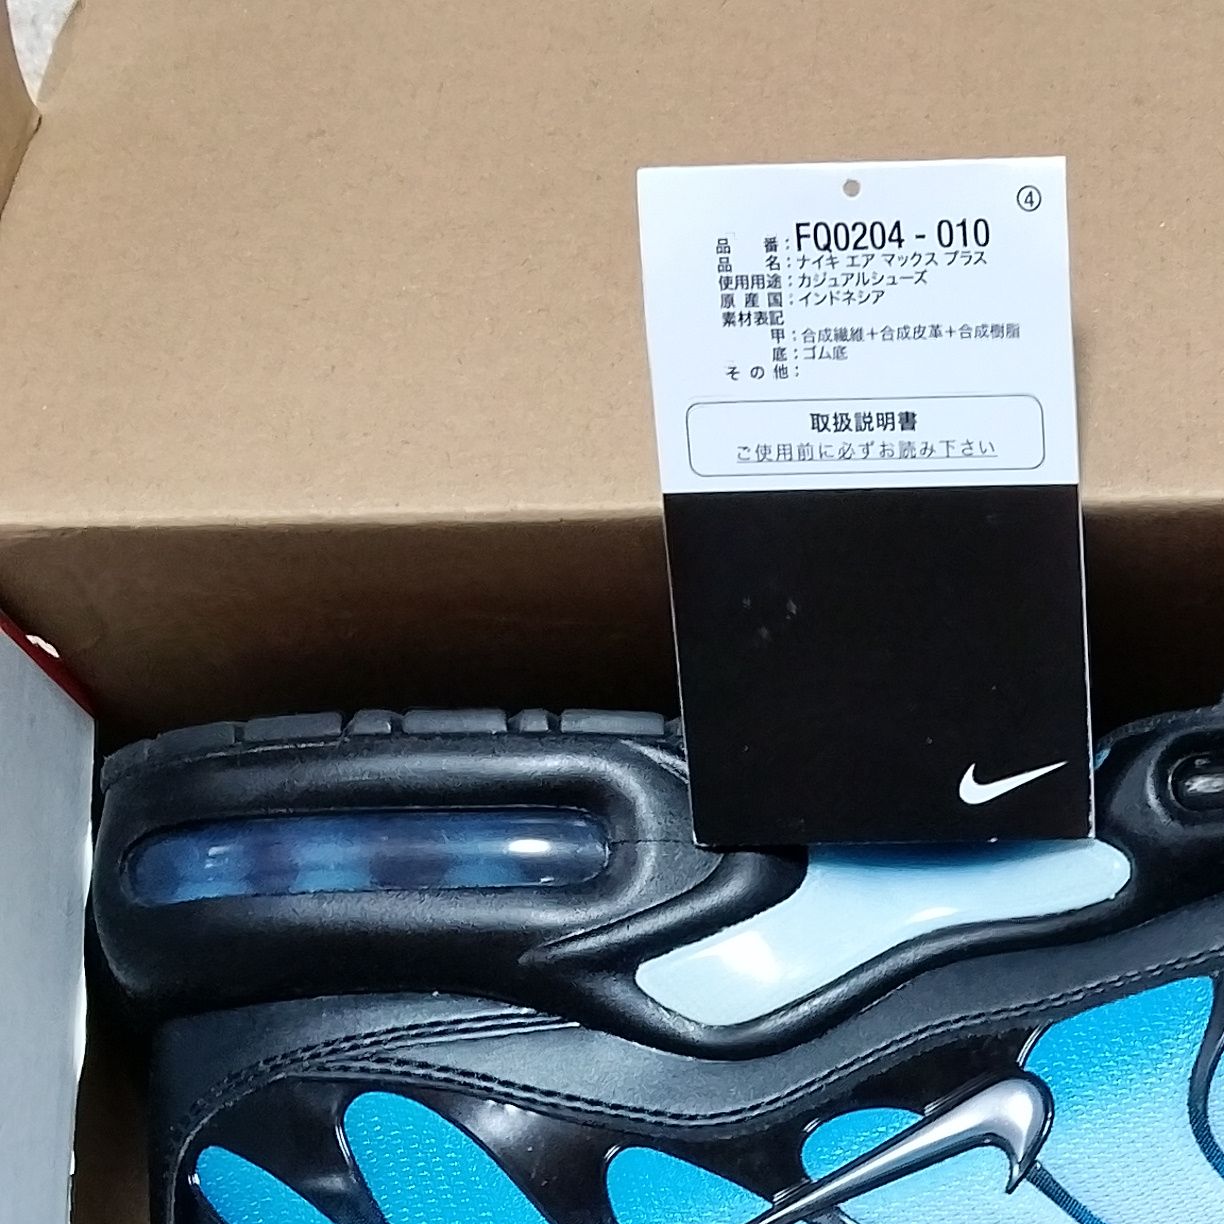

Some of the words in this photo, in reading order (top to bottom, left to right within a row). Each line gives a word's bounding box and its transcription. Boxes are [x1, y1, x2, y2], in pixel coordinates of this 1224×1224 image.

[795, 220, 905, 253] FQ0204
[937, 218, 990, 248] 010
[722, 310, 785, 328] 素材表記
[810, 411, 918, 433] 取扱説明書
[737, 438, 996, 462] ご使用前に必ずお読み下さい
